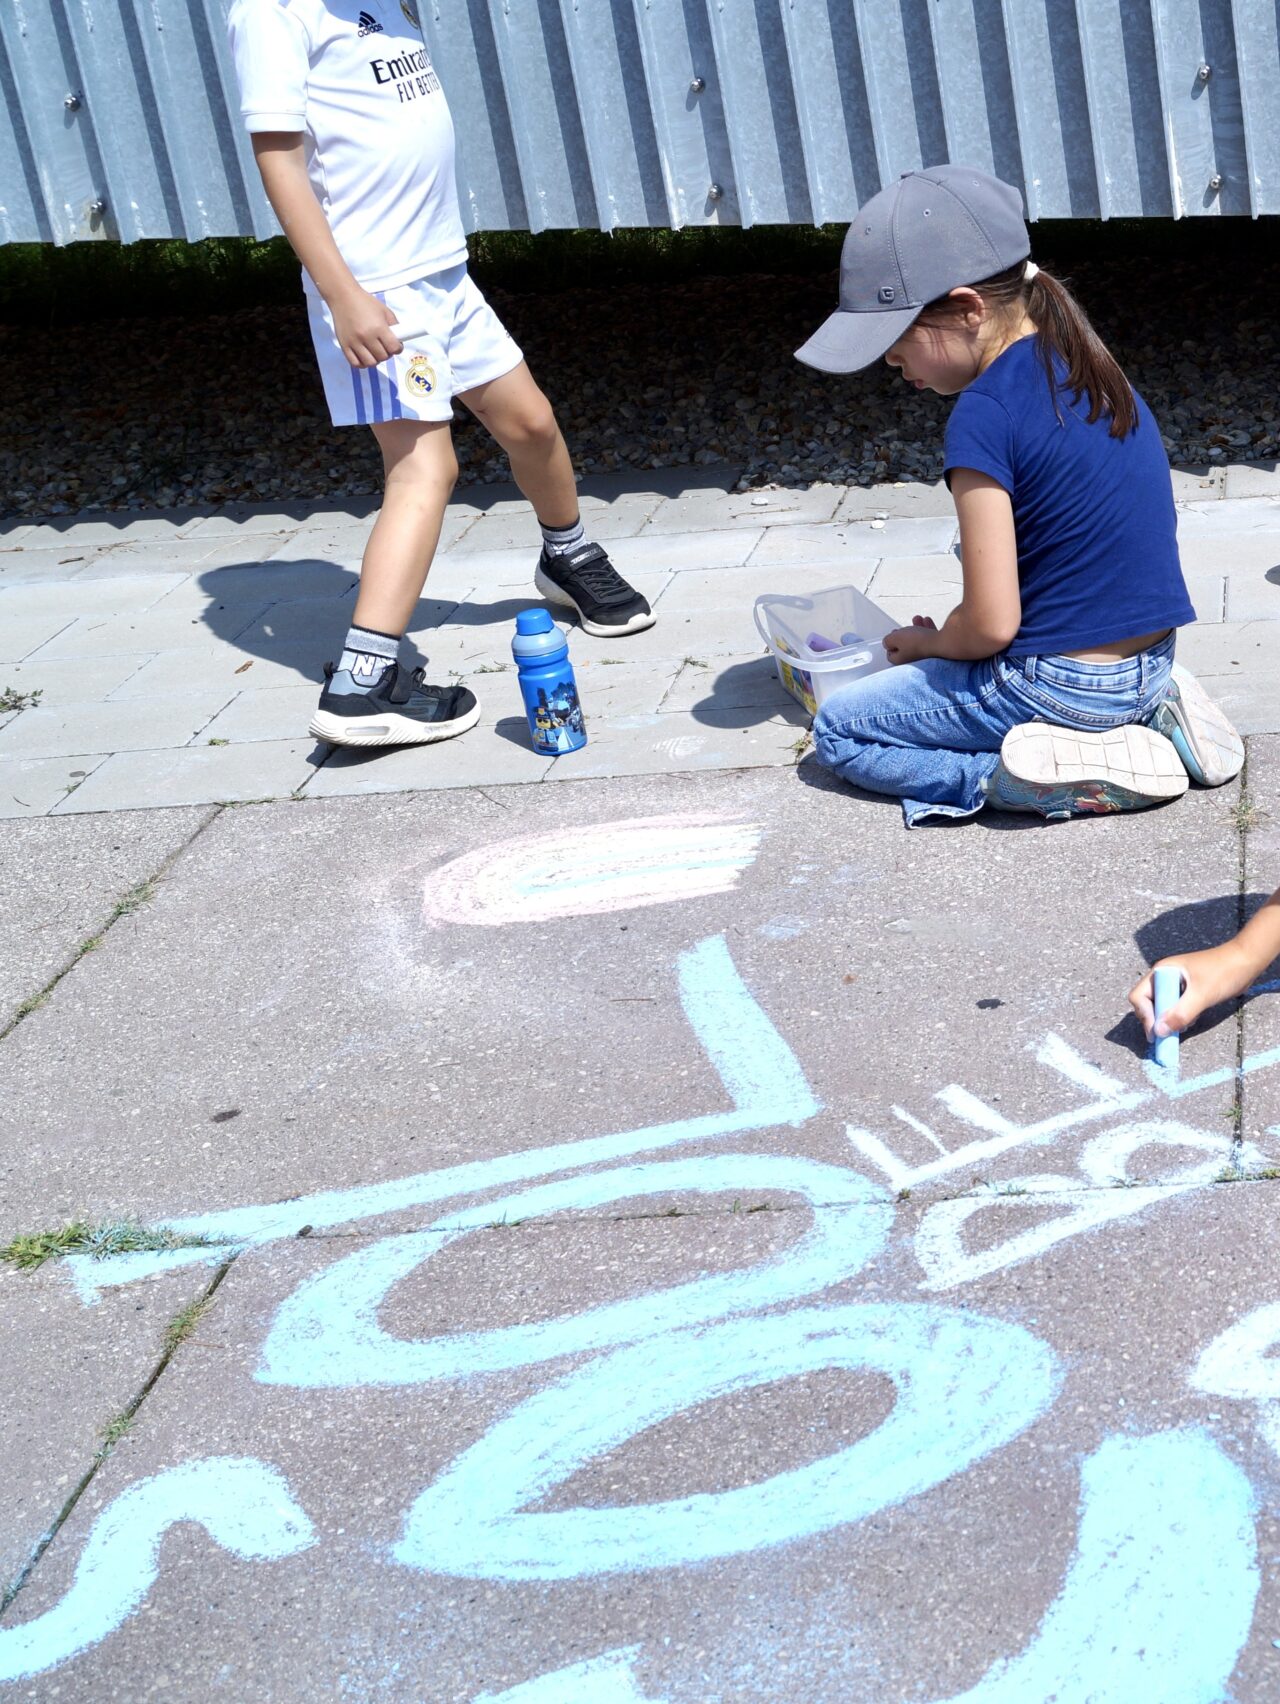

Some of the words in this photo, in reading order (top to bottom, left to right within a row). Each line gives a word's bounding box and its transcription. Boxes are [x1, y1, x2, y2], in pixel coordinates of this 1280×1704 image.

[357, 23, 384, 38] adidas
[369, 49, 431, 84] Emirate
[396, 80, 417, 103] FLY
